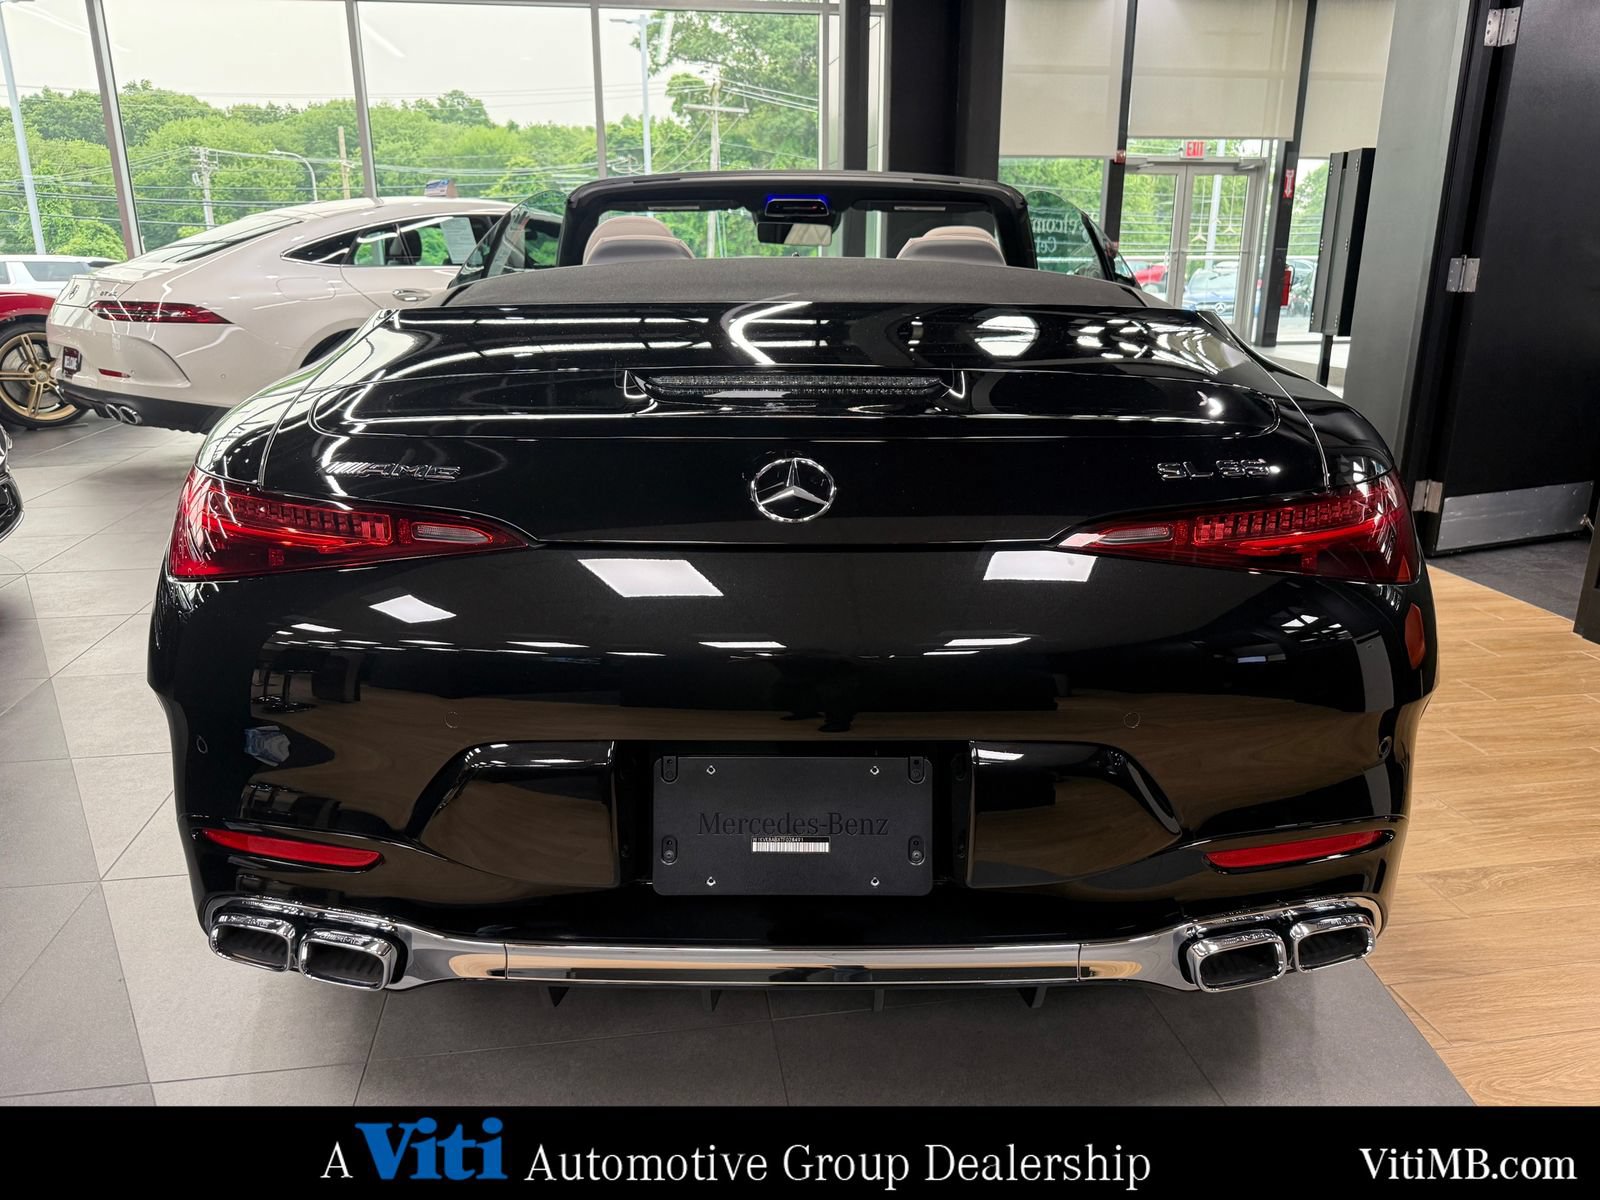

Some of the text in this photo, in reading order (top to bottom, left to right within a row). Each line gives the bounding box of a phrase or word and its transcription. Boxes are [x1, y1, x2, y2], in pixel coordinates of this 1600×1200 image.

[358, 462, 462, 481] AMG
[1157, 461, 1214, 481] SL
[698, 812, 889, 836] Mercedes-Benz
